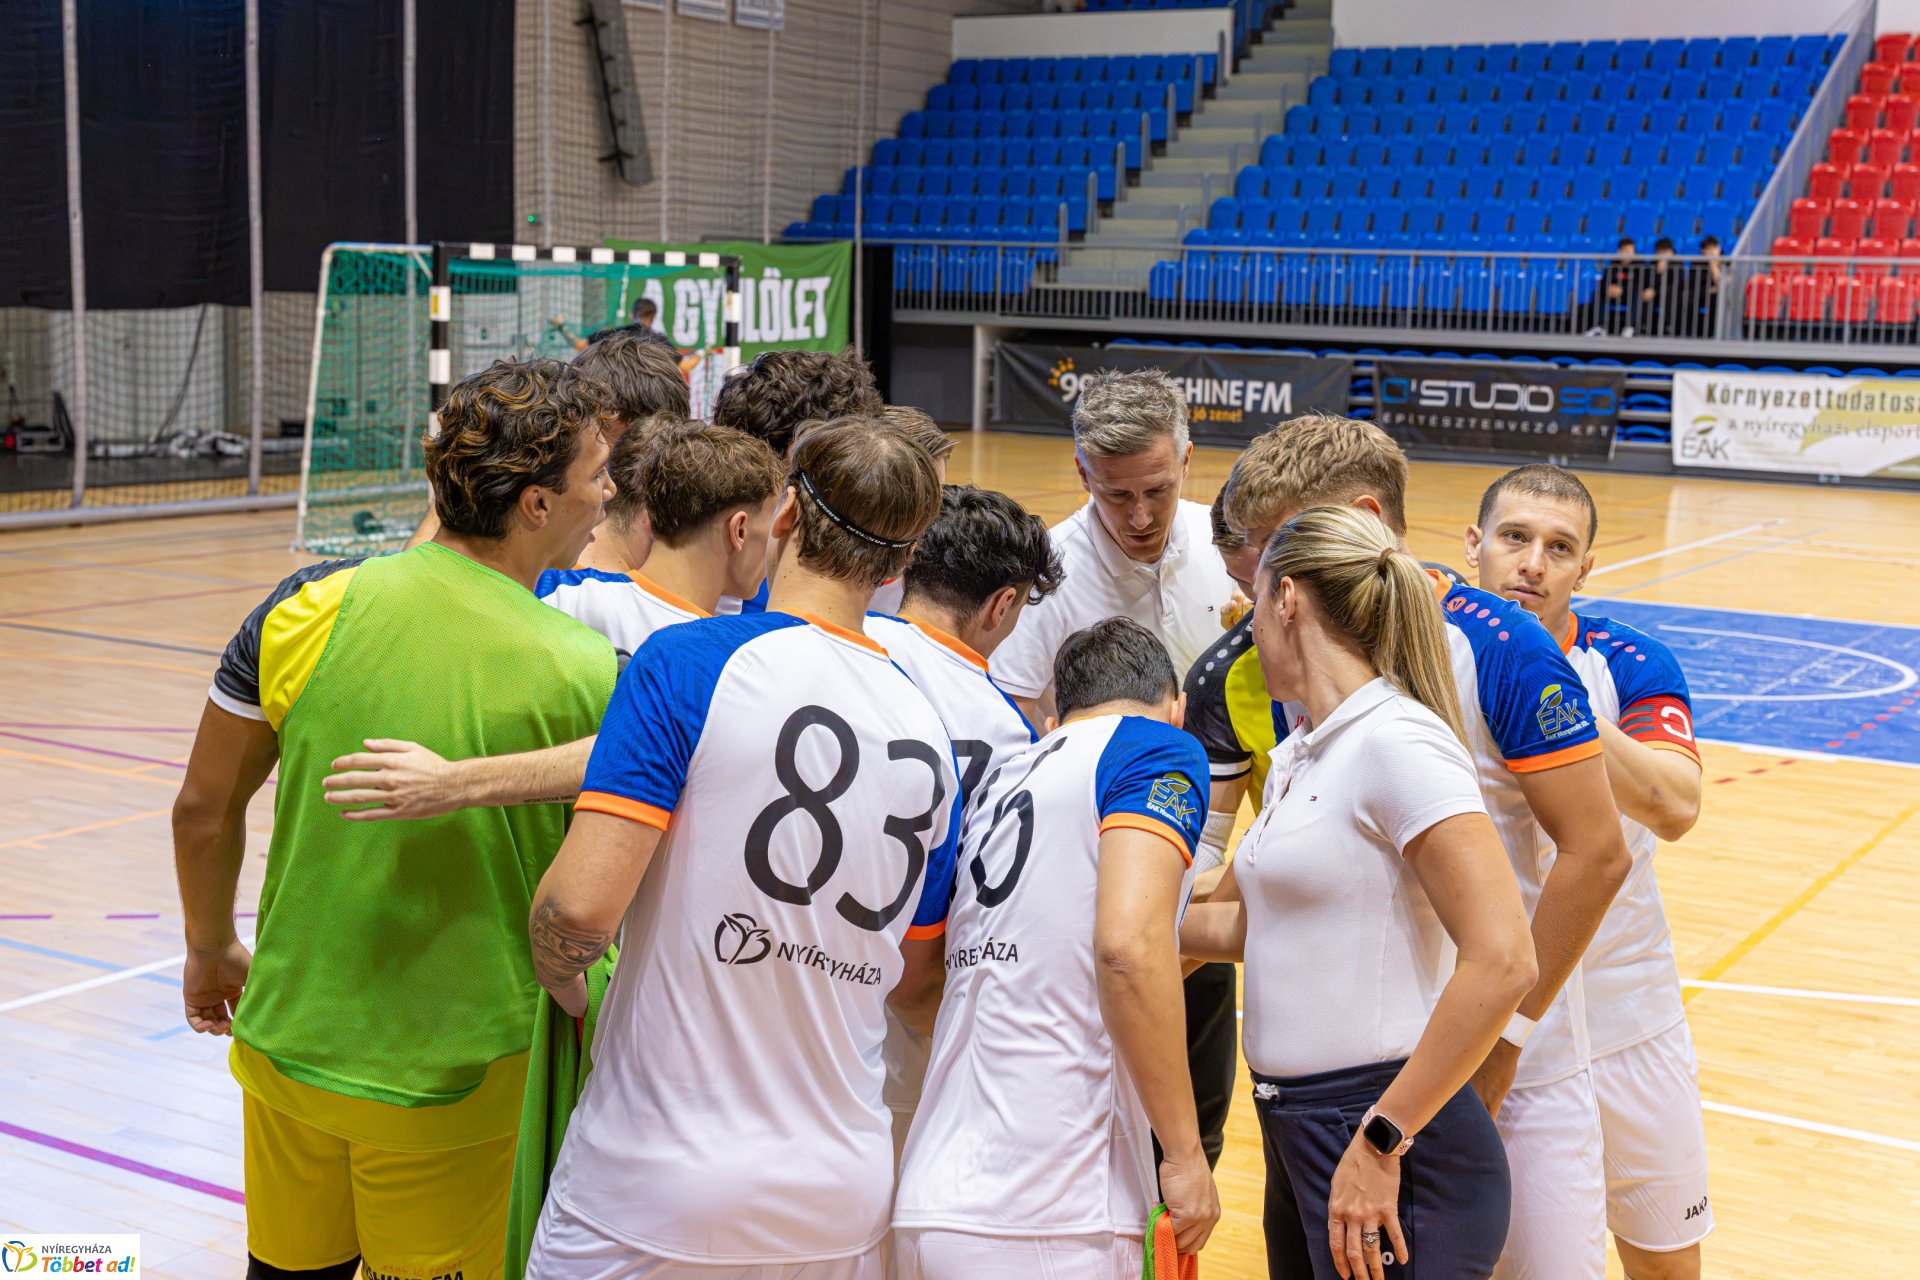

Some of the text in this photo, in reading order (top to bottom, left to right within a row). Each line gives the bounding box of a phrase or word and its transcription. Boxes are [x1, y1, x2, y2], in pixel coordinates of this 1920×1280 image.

[1706, 381, 1920, 413] Környezettudatos
[744, 705, 945, 932] 83
[777, 941, 881, 986] NYÍRYHÁZA
